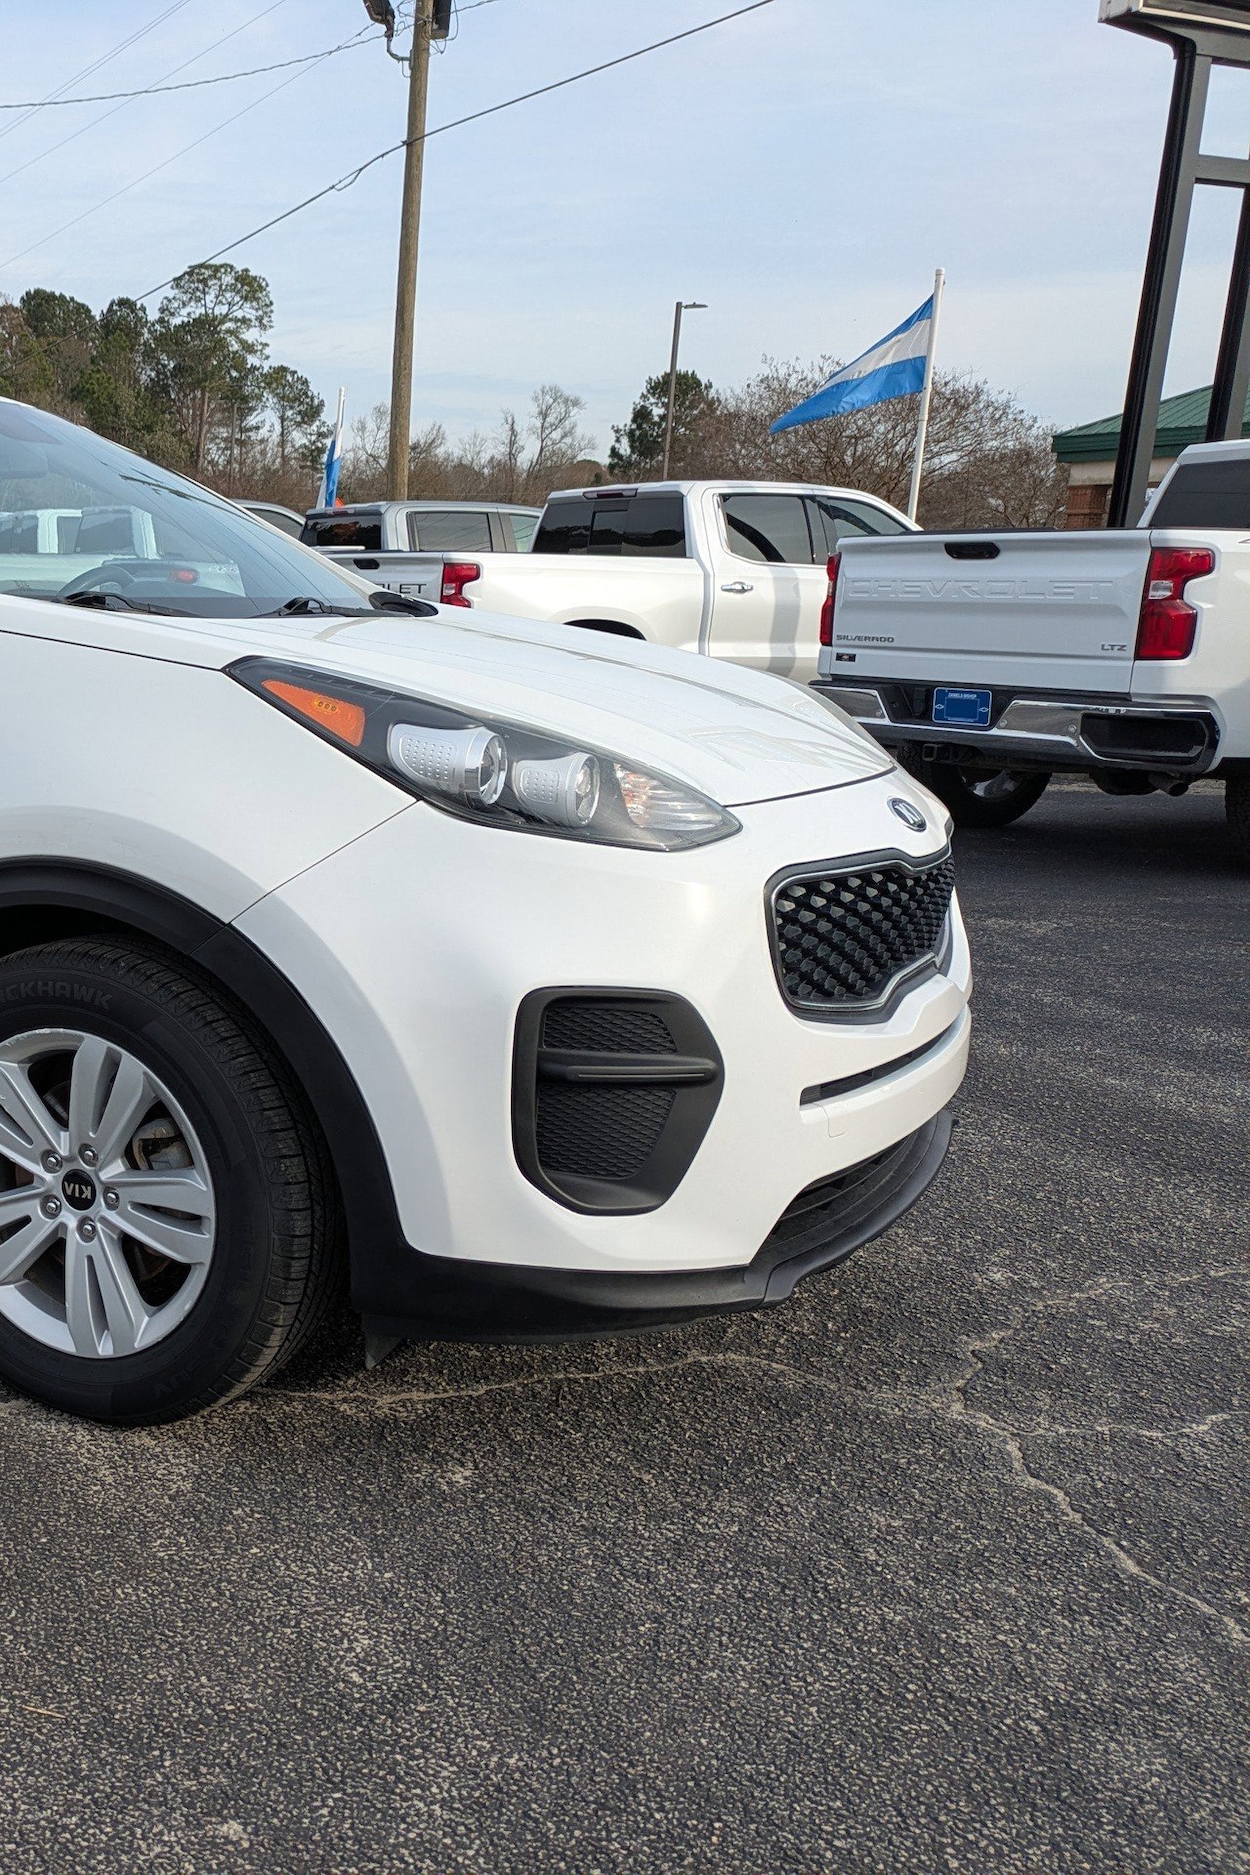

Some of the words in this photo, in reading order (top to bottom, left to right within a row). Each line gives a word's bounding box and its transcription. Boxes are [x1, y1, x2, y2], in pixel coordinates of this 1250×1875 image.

[848, 579, 1114, 600] CHEVROLET
[835, 633, 895, 644] SILVERADO
[1101, 643, 1128, 652] LTZ
[63, 1180, 92, 1200] KIA
